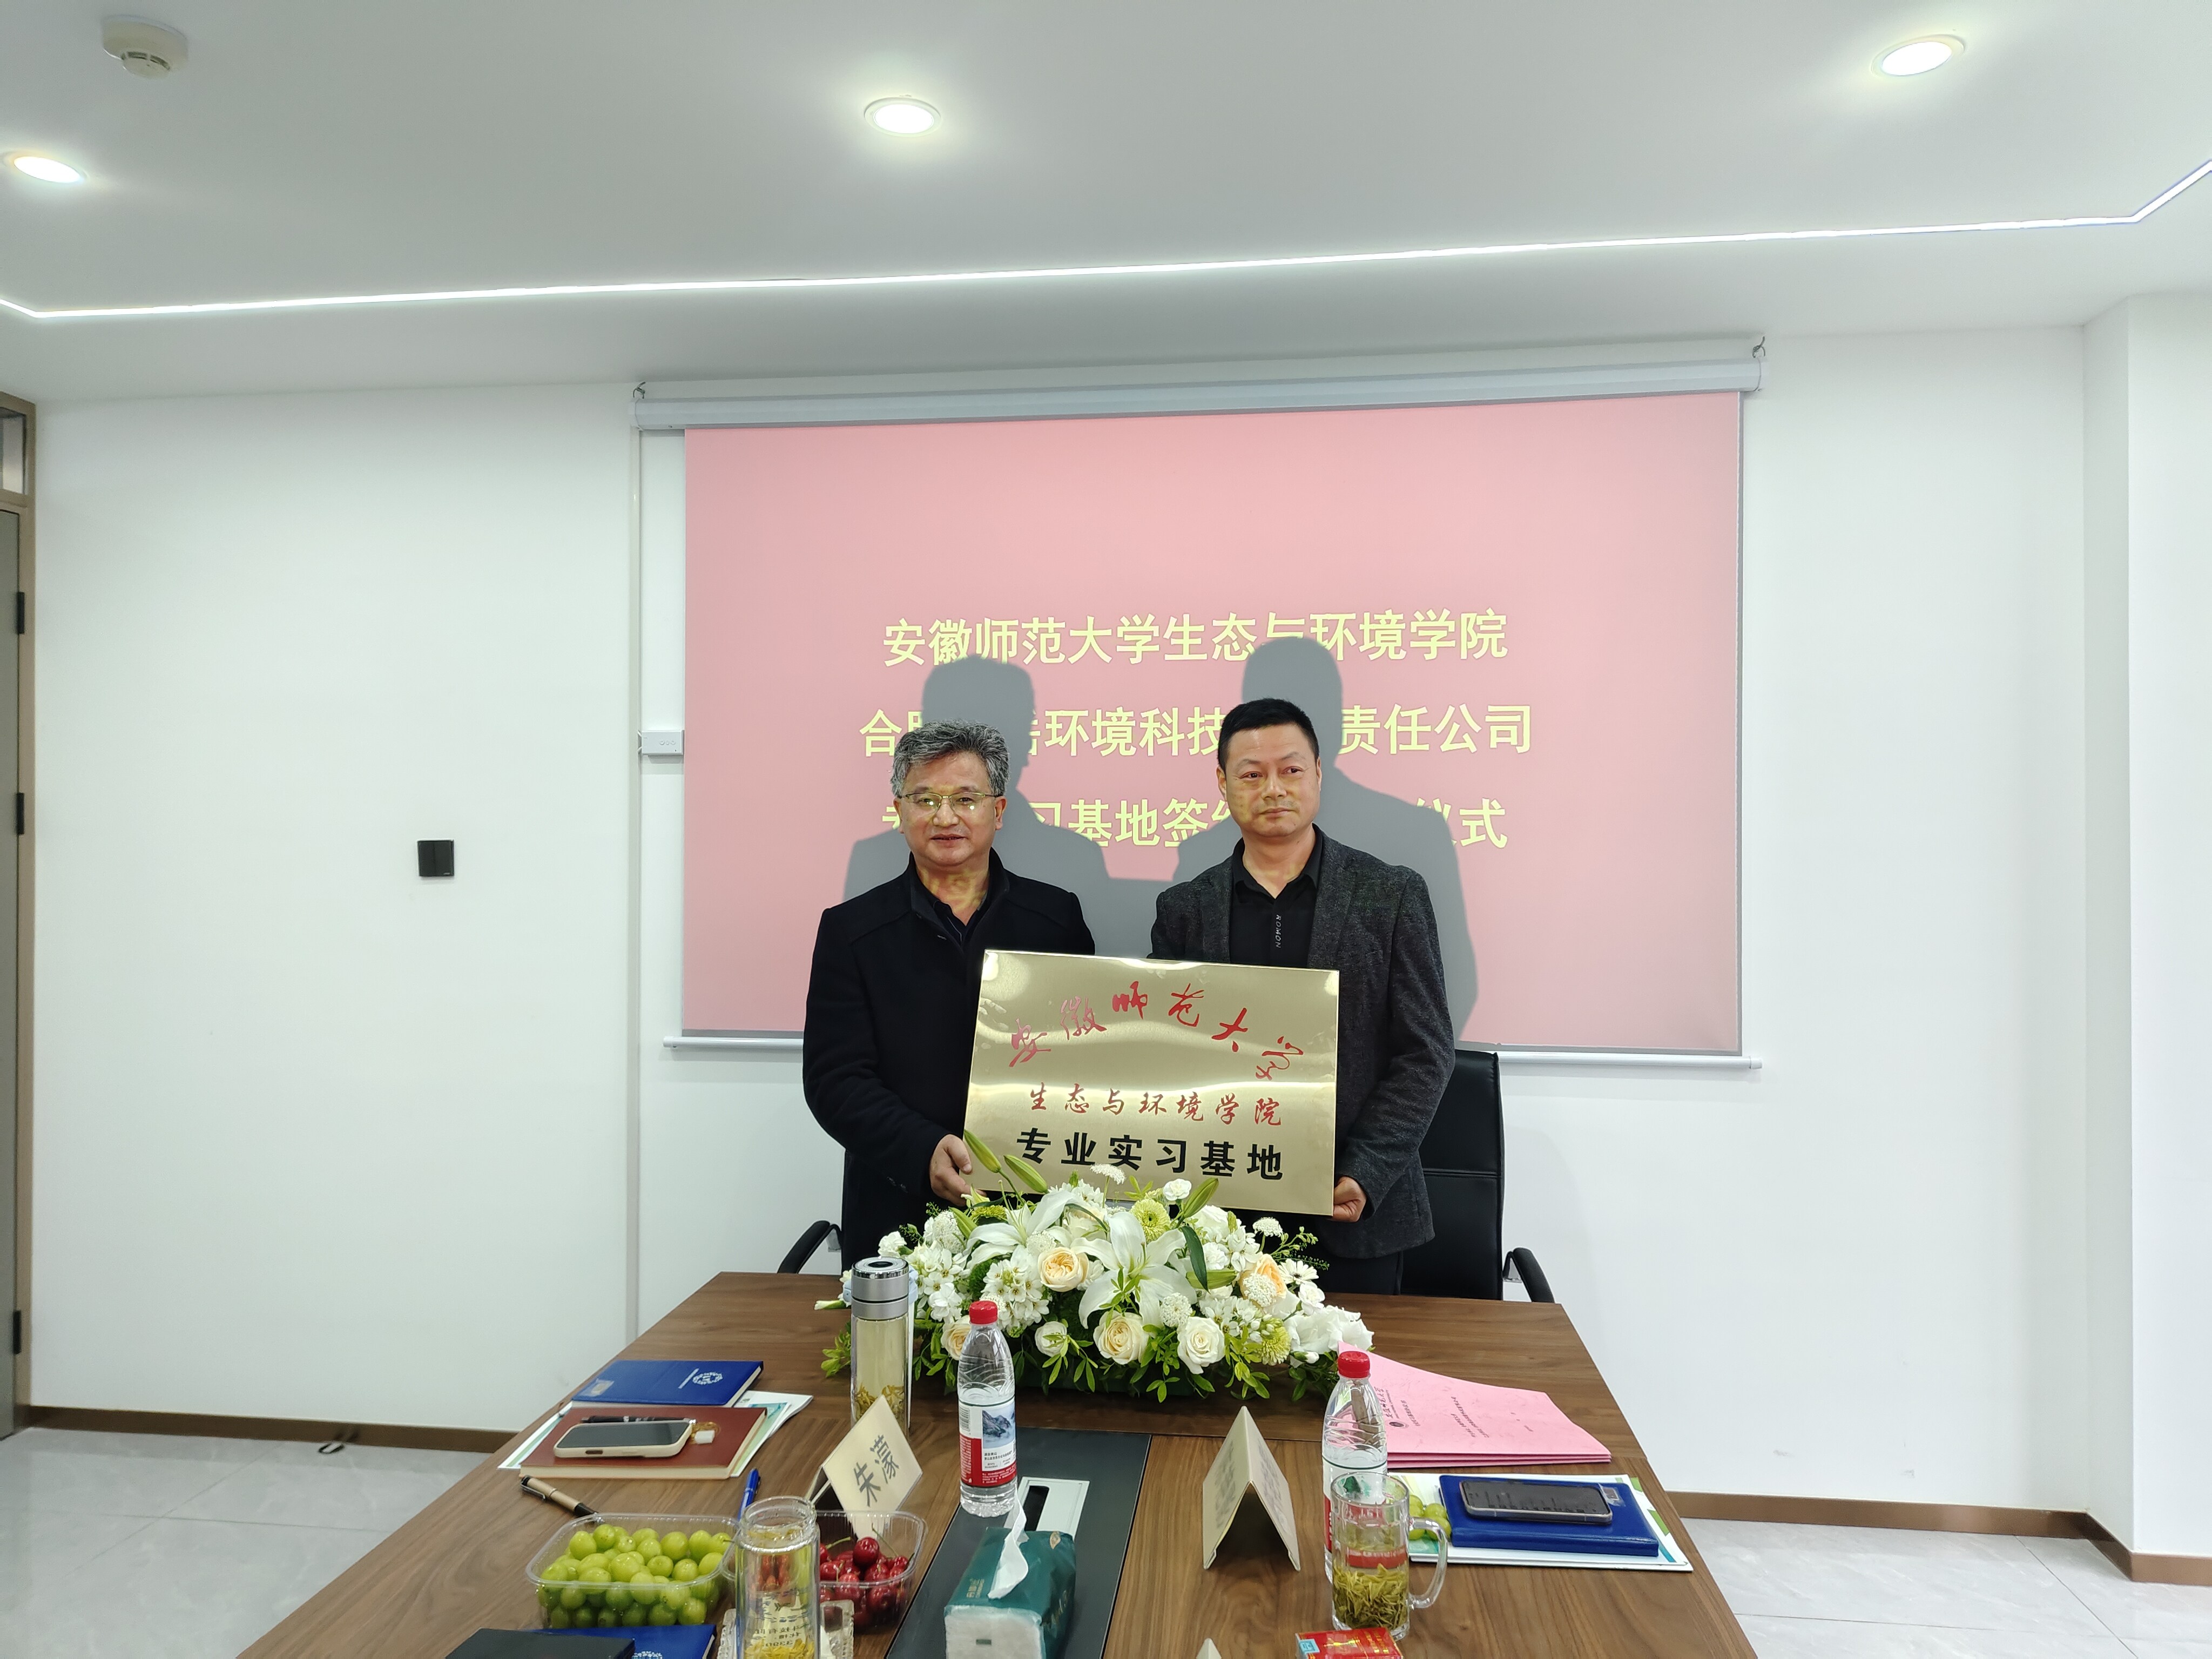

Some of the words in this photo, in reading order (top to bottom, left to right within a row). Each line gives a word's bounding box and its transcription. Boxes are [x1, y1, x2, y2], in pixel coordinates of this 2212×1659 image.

[1009, 981, 1304, 1081] 安徽师范大学
[1029, 1082, 1282, 1127] 生态与环境学院
[1016, 1127, 1283, 1181] 专业实习基地
[853, 1434, 900, 1507] 朱濛
